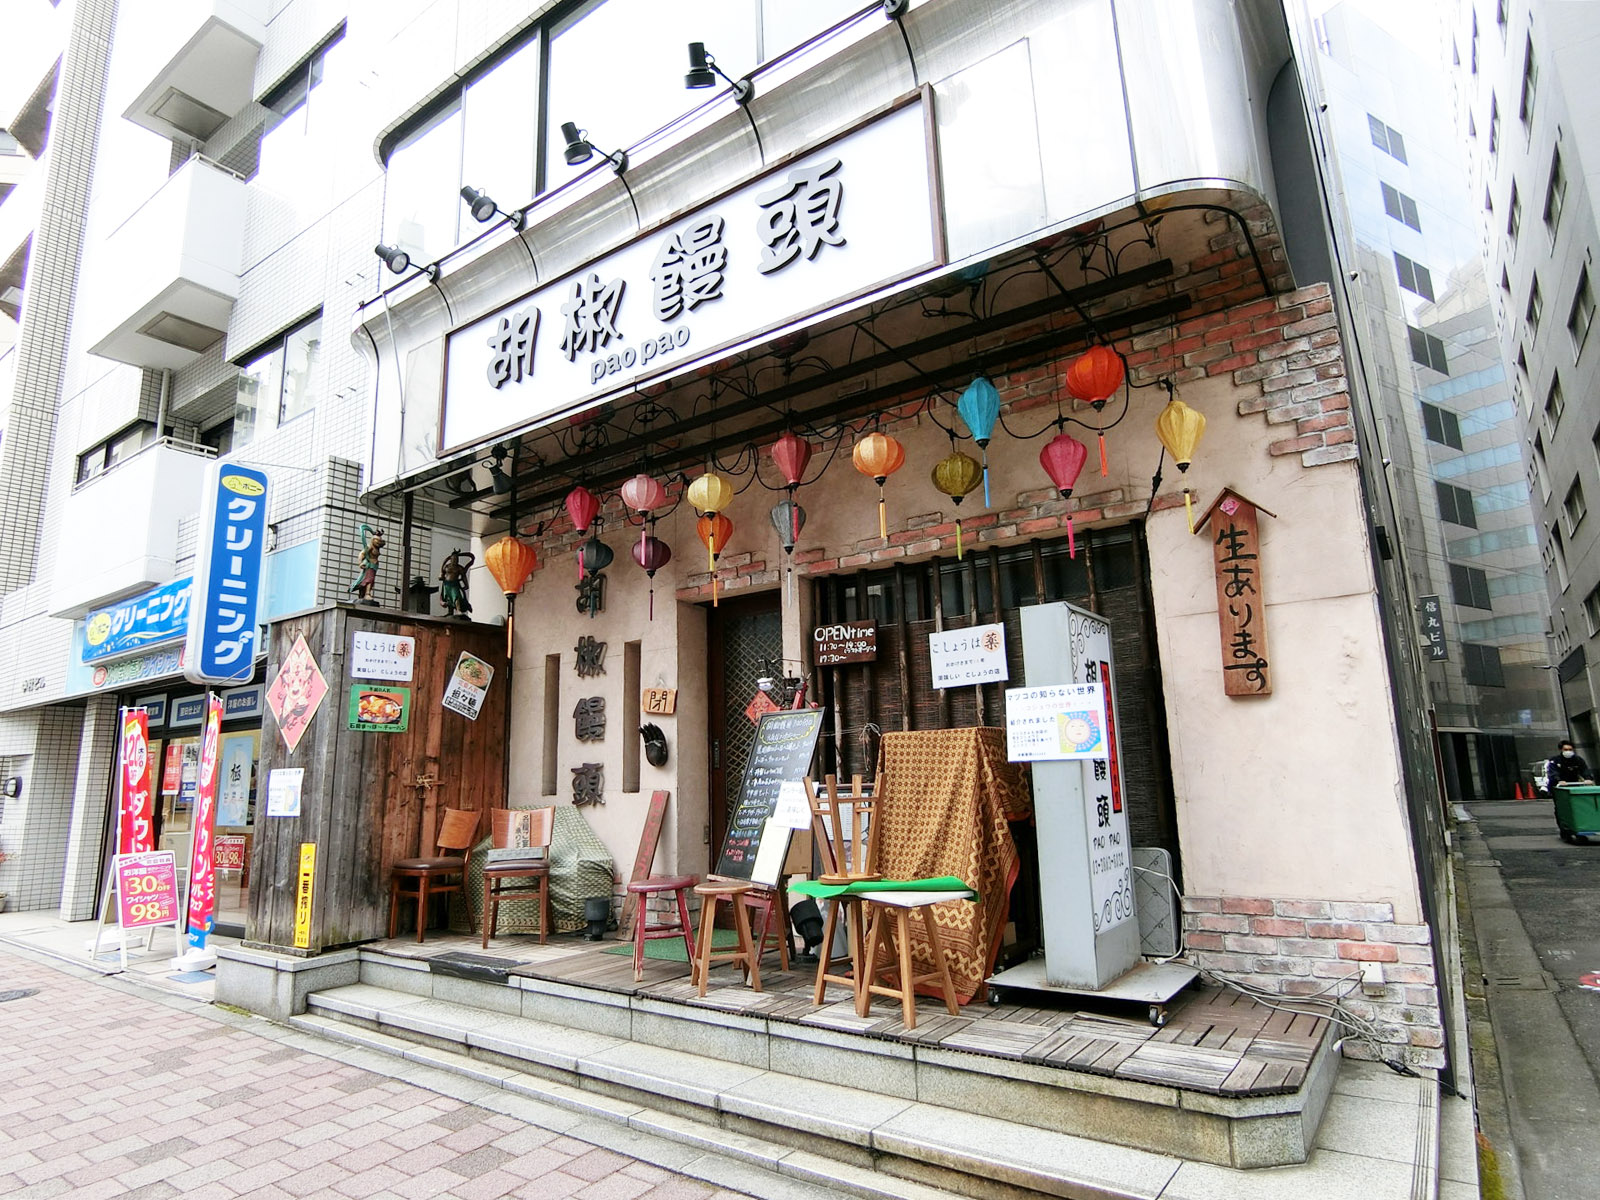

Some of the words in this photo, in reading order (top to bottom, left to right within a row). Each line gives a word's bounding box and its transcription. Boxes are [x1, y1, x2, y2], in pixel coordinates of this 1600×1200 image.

[486, 157, 847, 389] 胡椒饅頭
[590, 346, 636, 384] pao
[641, 325, 691, 367] pao
[214, 497, 257, 665] クリーニング
[112, 584, 193, 635] クリーニング
[1215, 522, 1269, 692] 生あります
[814, 624, 851, 642] OPEN
[1007, 685, 1096, 701] マツコの知らない世界
[1010, 716, 1056, 726] 紹介されました
[1093, 834, 1106, 850] PAO
[1109, 831, 1121, 847] PAO
[127, 875, 158, 895] 30
[126, 893, 159, 904] ワイシャツ
[130, 901, 162, 923] 98
[161, 909, 170, 917] 円
